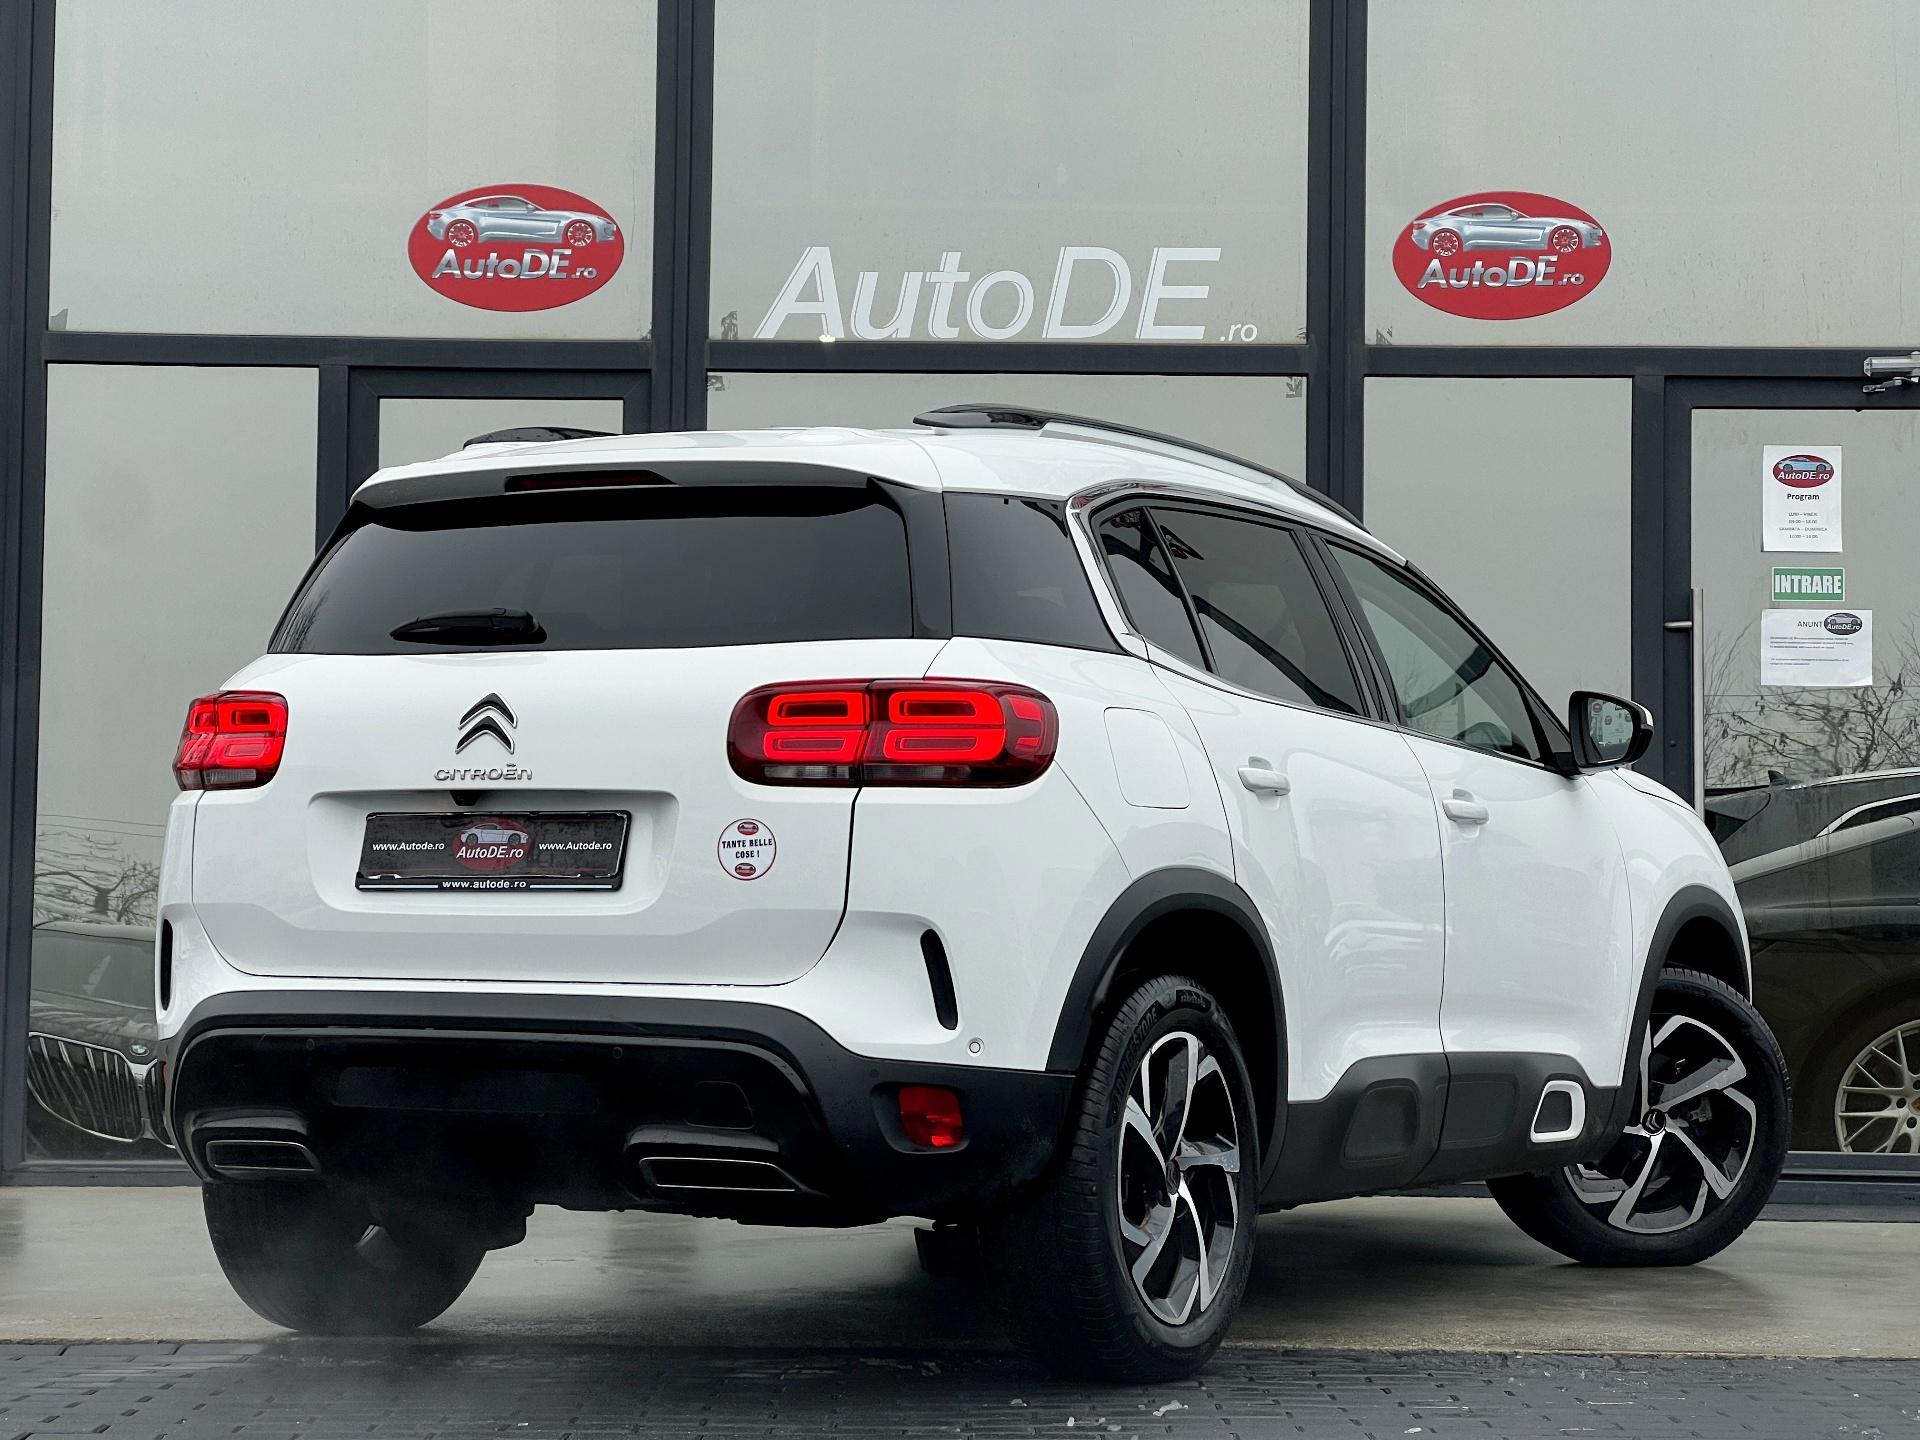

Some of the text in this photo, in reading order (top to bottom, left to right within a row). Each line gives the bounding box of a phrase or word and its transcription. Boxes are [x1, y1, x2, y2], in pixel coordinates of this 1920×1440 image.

[1777, 471, 1830, 480] AutoDE.ro
[1786, 493, 1820, 501] Program
[1774, 574, 1842, 593] INTRARE
[372, 841, 445, 851] www.Autode.ro
[539, 841, 612, 851] www.Autode.ro
[722, 838, 773, 848] TANTE BELLE
[456, 846, 524, 859] AutoDE.ro
[735, 850, 755, 858] COSE
[442, 879, 527, 889] www.autode.ro
